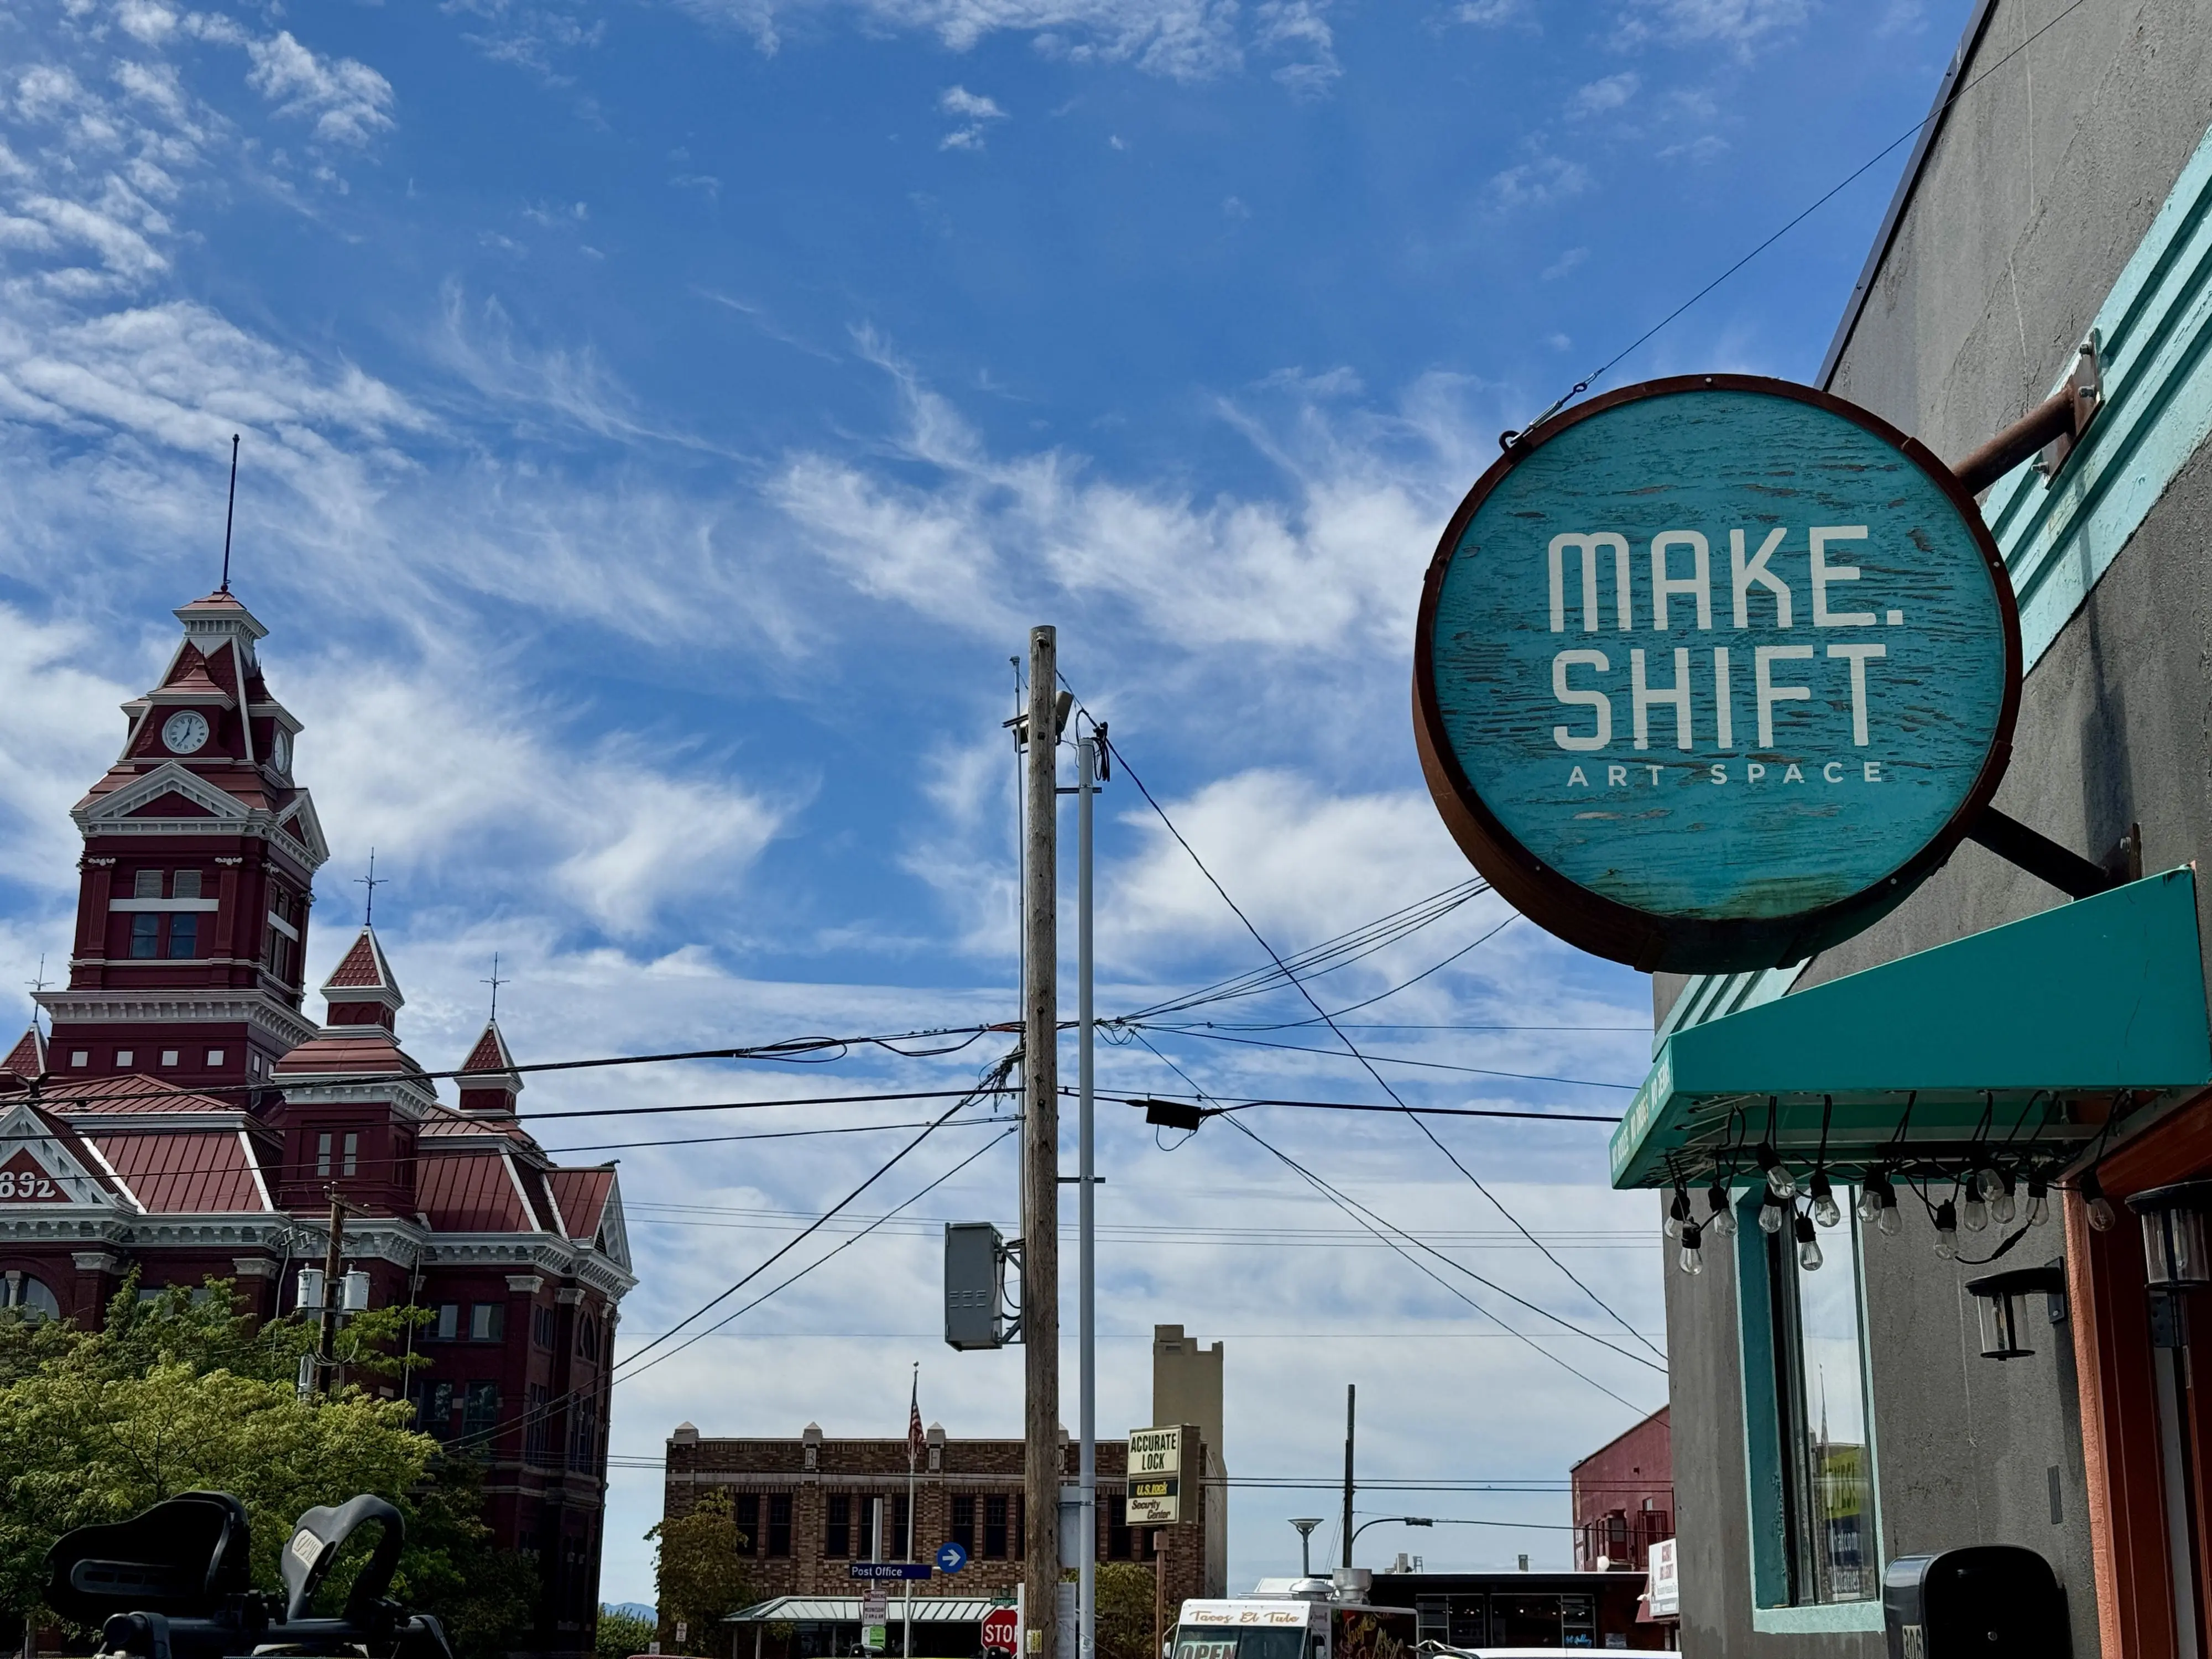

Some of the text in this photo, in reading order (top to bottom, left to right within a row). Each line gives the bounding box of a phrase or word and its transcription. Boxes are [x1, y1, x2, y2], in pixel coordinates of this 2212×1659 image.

[1548, 525, 1903, 632] MAKE.
[1552, 644, 1886, 751] SHIFT
[1567, 761, 1882, 787] ART SPACE
[1130, 1433, 1176, 1453] ACCURATE
[1142, 1453, 1165, 1470] LOCK
[1131, 1499, 1161, 1511] Security
[1147, 1509, 1171, 1520] Center
[852, 1566, 902, 1576] Post Office
[1190, 1610, 1234, 1623] Tacos
[1240, 1611, 1259, 1623] El
[1177, 1645, 1237, 1659] OPEN
